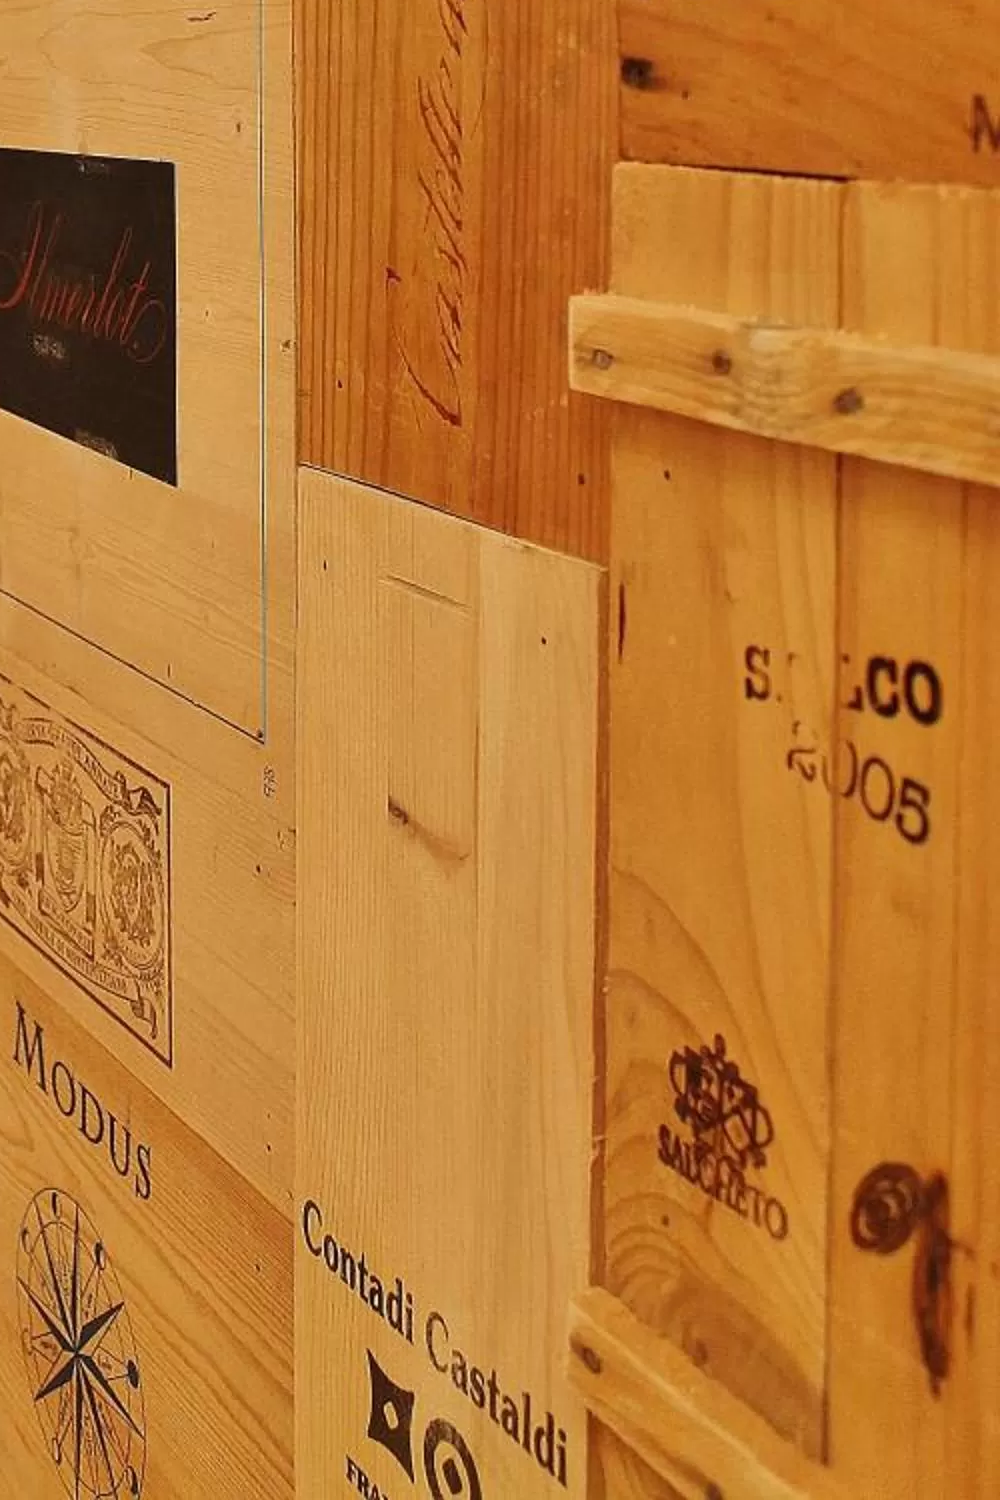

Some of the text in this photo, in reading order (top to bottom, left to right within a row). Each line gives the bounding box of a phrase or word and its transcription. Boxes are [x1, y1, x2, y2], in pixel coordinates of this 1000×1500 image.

[383, 60, 468, 430] Castello
[744, 644, 942, 728] SCO
[11, 1000, 152, 1202] MODUS
[303, 1199, 415, 1346] Contadi
[346, 1453, 391, 1500] FRA
[425, 1310, 569, 1490] Castaldi
